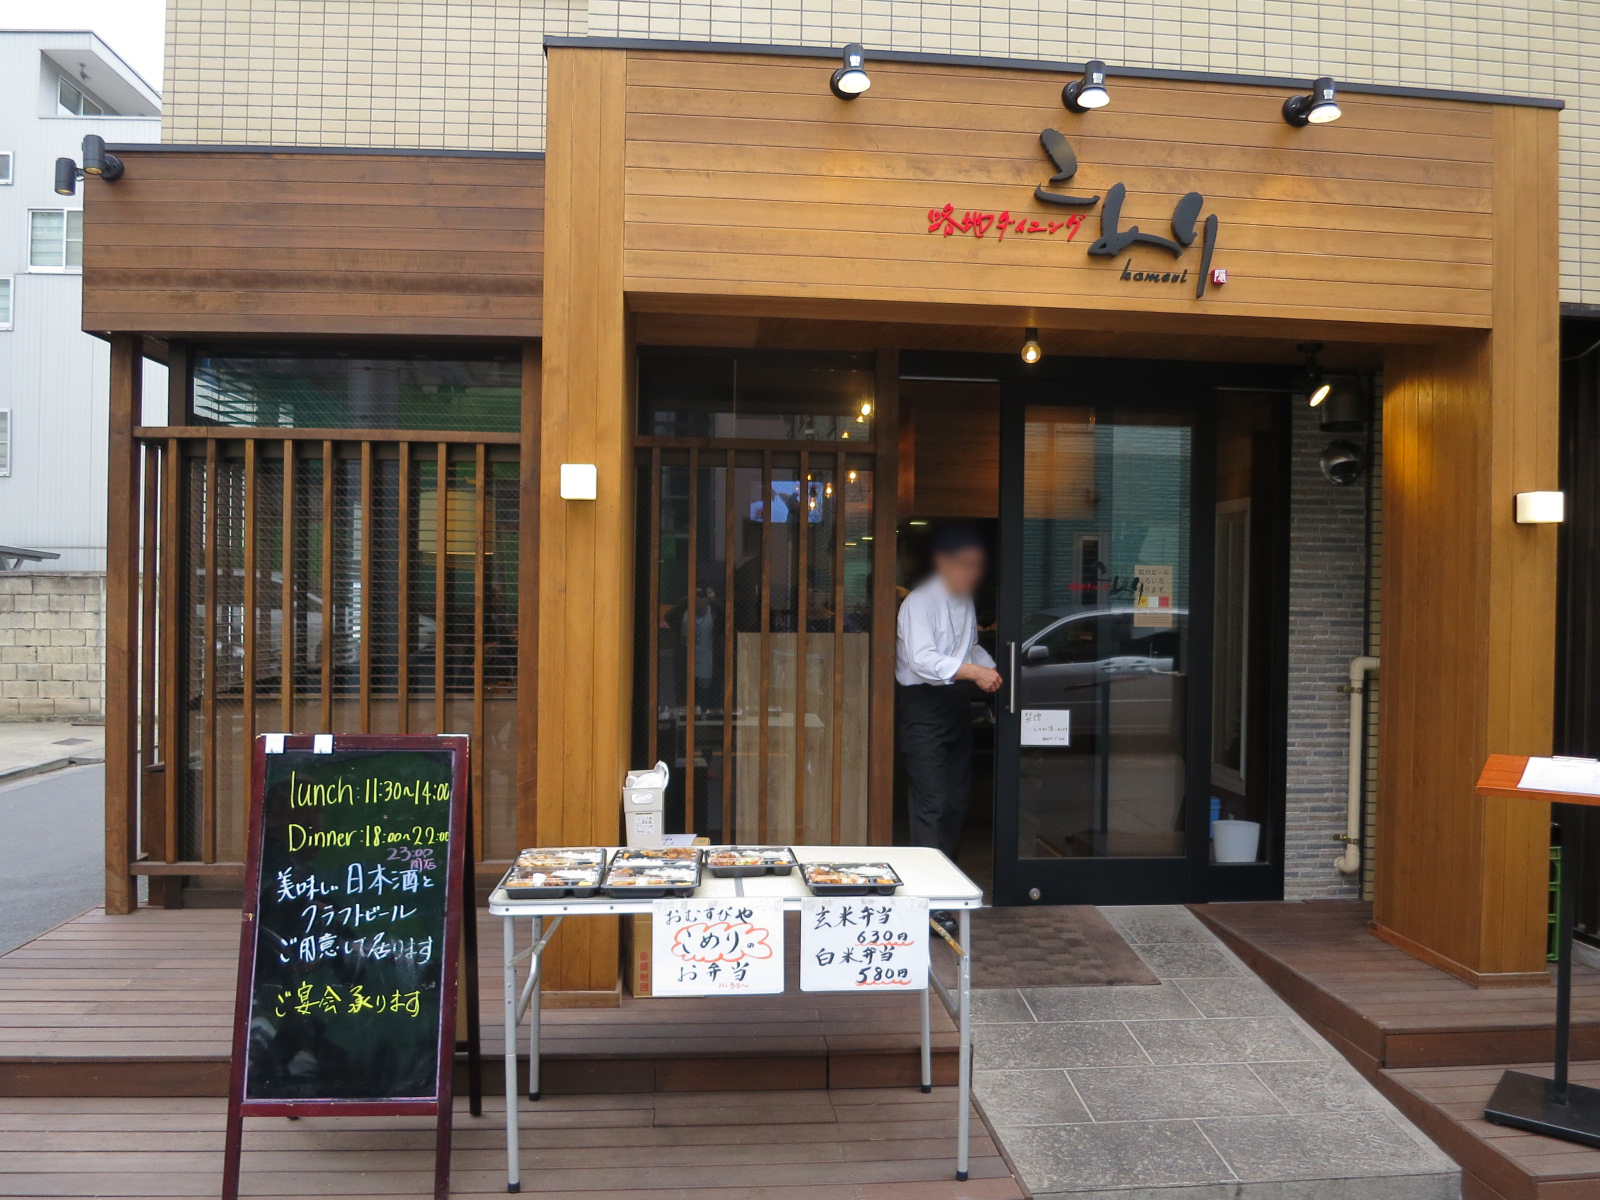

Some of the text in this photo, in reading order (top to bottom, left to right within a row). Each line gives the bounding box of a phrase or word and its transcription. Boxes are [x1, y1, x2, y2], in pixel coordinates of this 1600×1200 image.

[928, 203, 1087, 242] 路地ダイニング
[301, 903, 417, 933] クラフトビール
[665, 907, 754, 925] おむすびや
[814, 905, 893, 930] 玄米弁当
[856, 930, 908, 944] 630円
[815, 946, 895, 967] 白米弁当
[677, 960, 750, 983] お弁当
[856, 966, 908, 984] 580円
